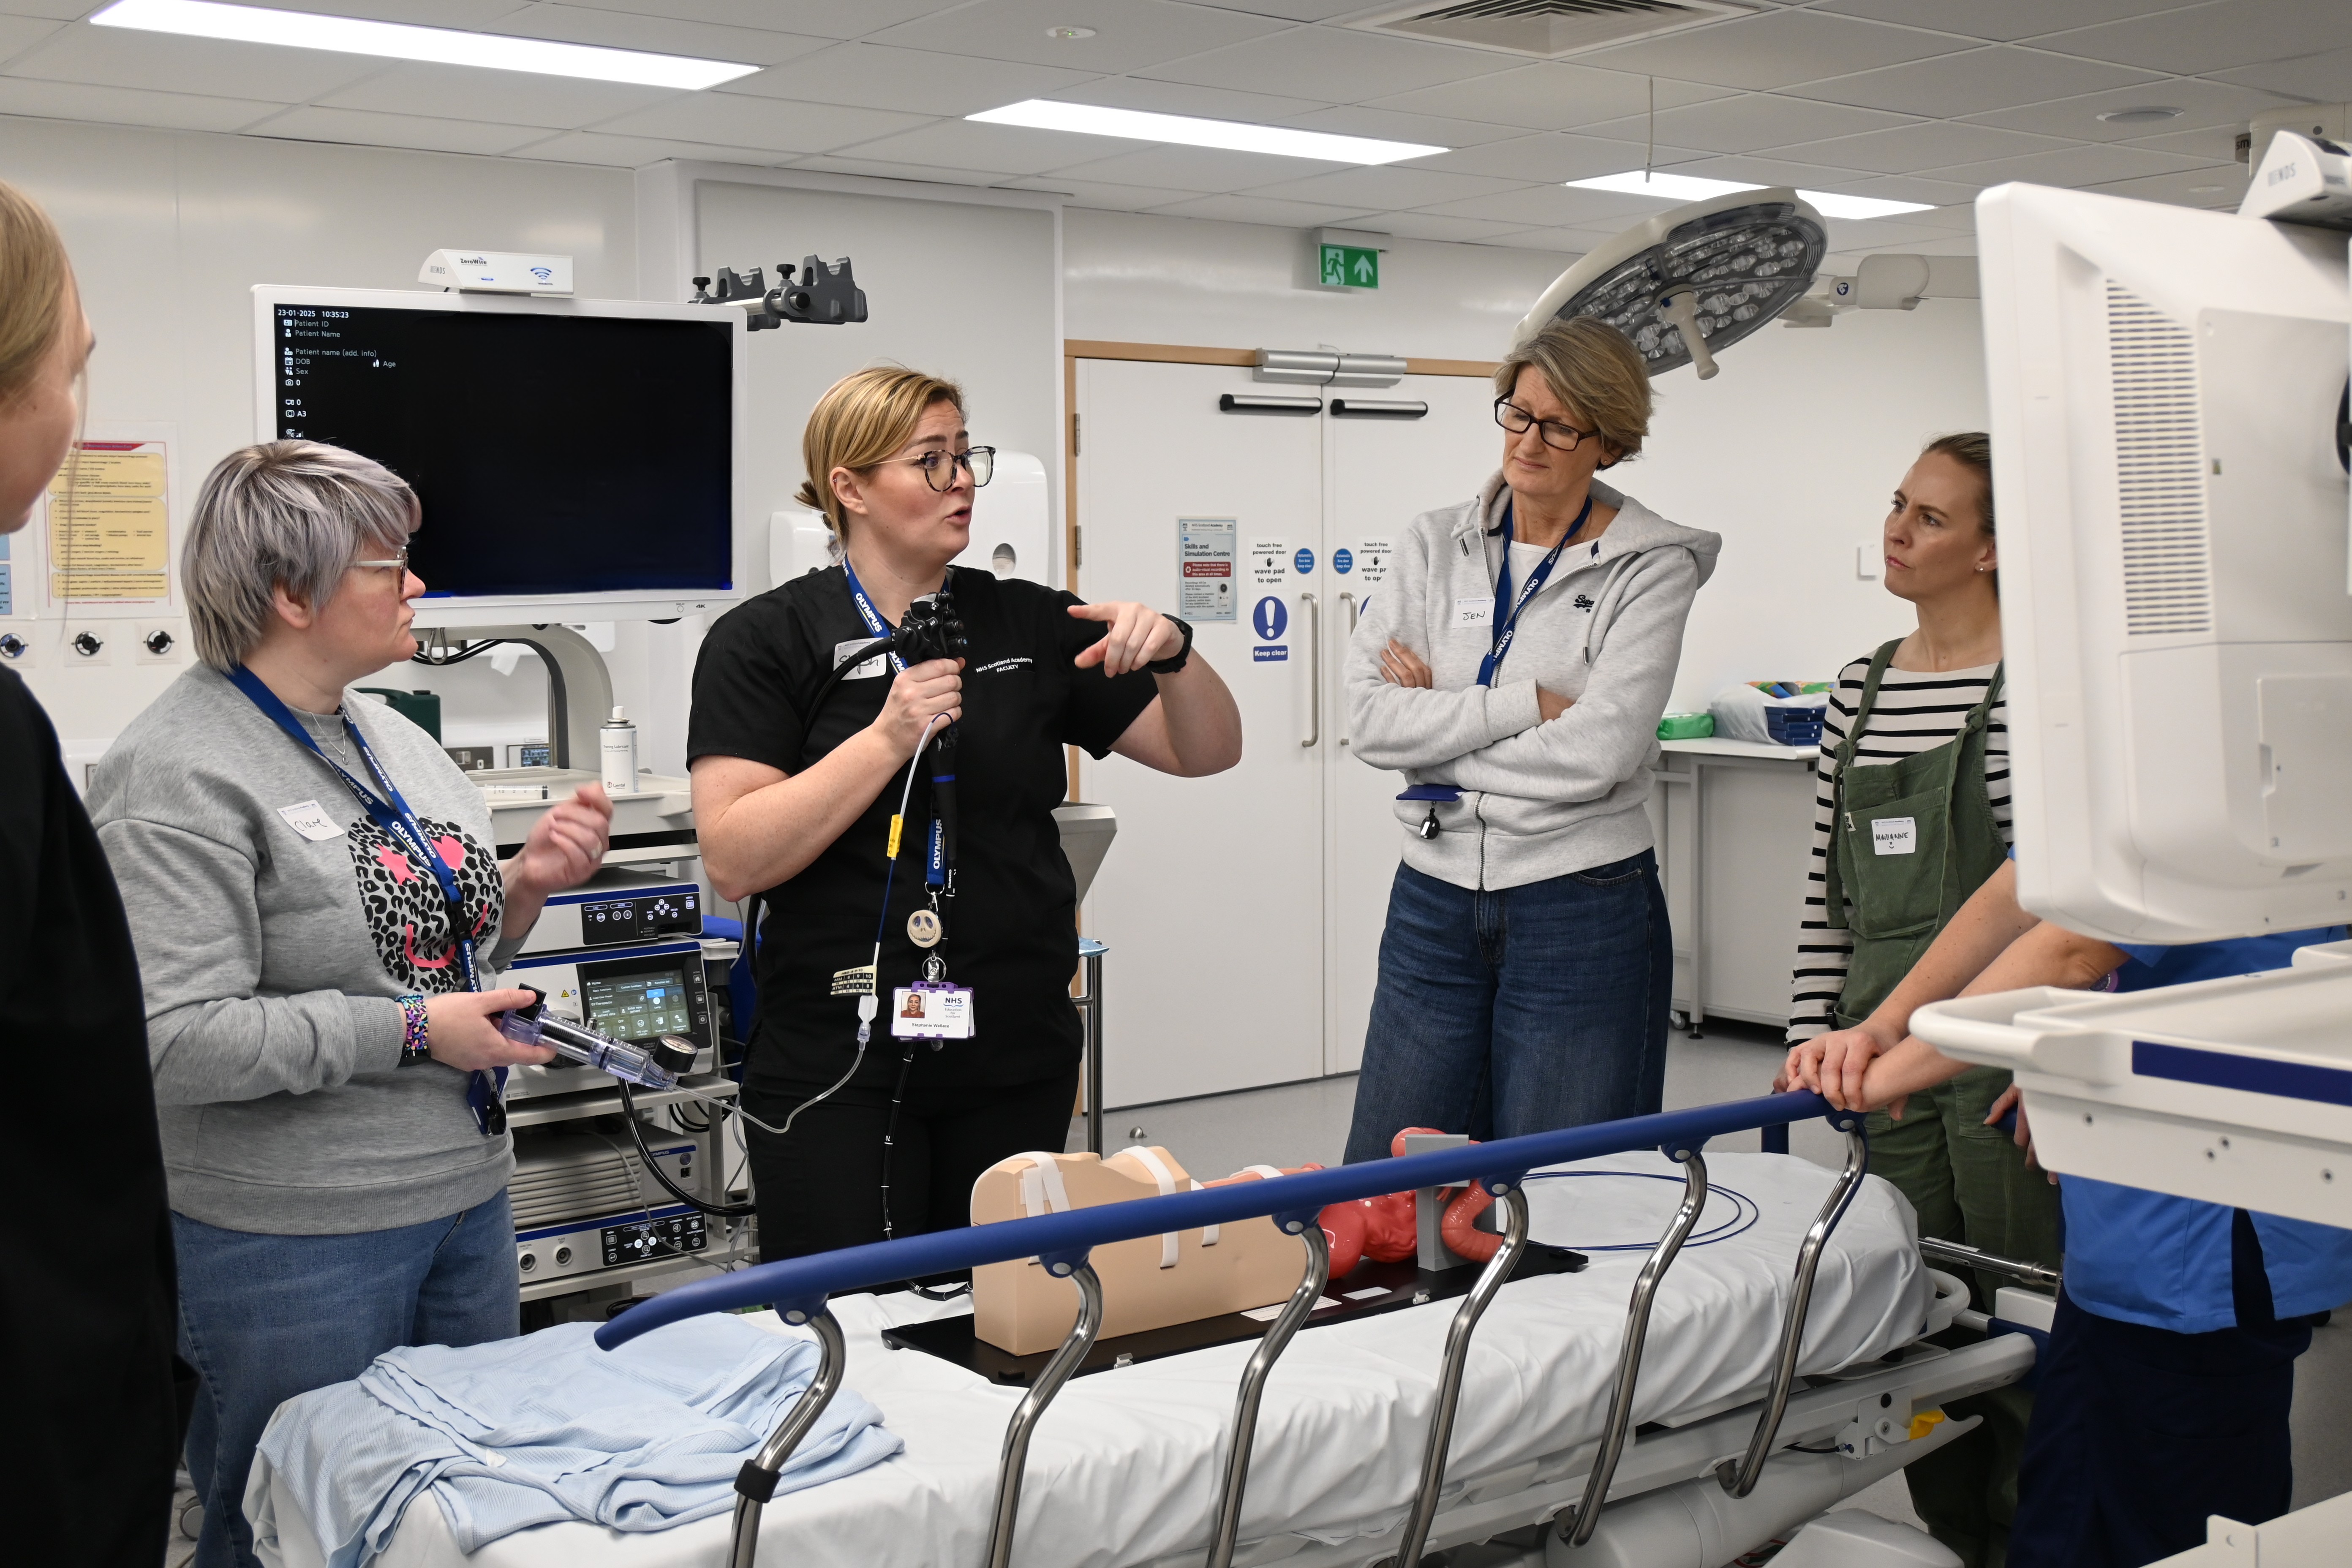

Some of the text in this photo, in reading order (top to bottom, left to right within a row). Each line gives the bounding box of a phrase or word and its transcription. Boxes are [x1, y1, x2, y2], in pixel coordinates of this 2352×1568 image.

[436, 266, 446, 274] NDS
[343, 349, 359, 357] (add.
[856, 593, 882, 632] OLYMPUS
[1463, 611, 1485, 621] JEN
[988, 658, 1010, 669] Scotland
[996, 664, 1018, 673] FACULTY
[363, 746, 393, 792] OLYMPUS
[294, 818, 327, 831] Clare
[404, 812, 436, 858] OLYMPUS
[392, 821, 432, 867] OLYMPUS
[933, 819, 942, 869] OLYMPUS
